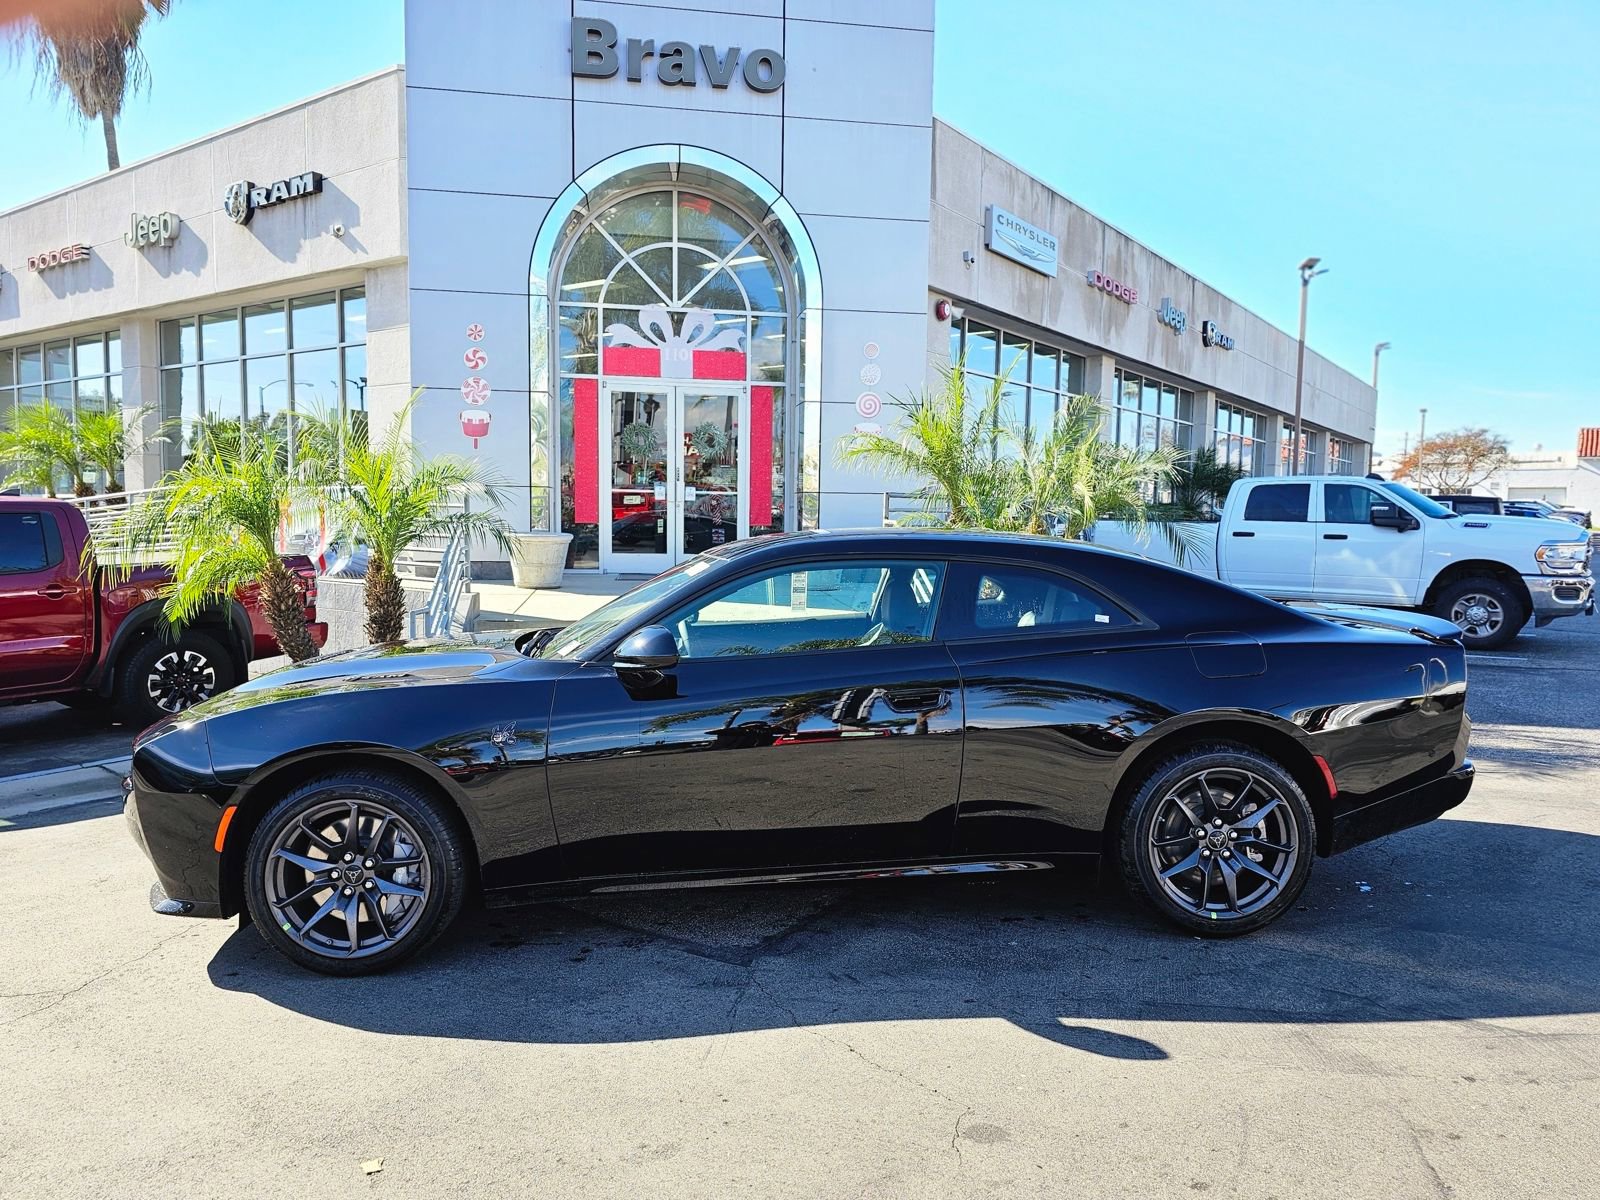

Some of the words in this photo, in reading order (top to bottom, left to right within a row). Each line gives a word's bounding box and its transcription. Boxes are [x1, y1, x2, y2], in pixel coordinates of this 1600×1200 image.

[572, 16, 786, 93] Bravo
[250, 171, 317, 208] RAM
[125, 211, 176, 248] Jeep
[996, 213, 1056, 251] CHRYSLER
[27, 243, 87, 272] DODGE
[1093, 270, 1138, 305] DODGE
[1161, 298, 1186, 336] Jeep
[1215, 331, 1235, 351] RAM
